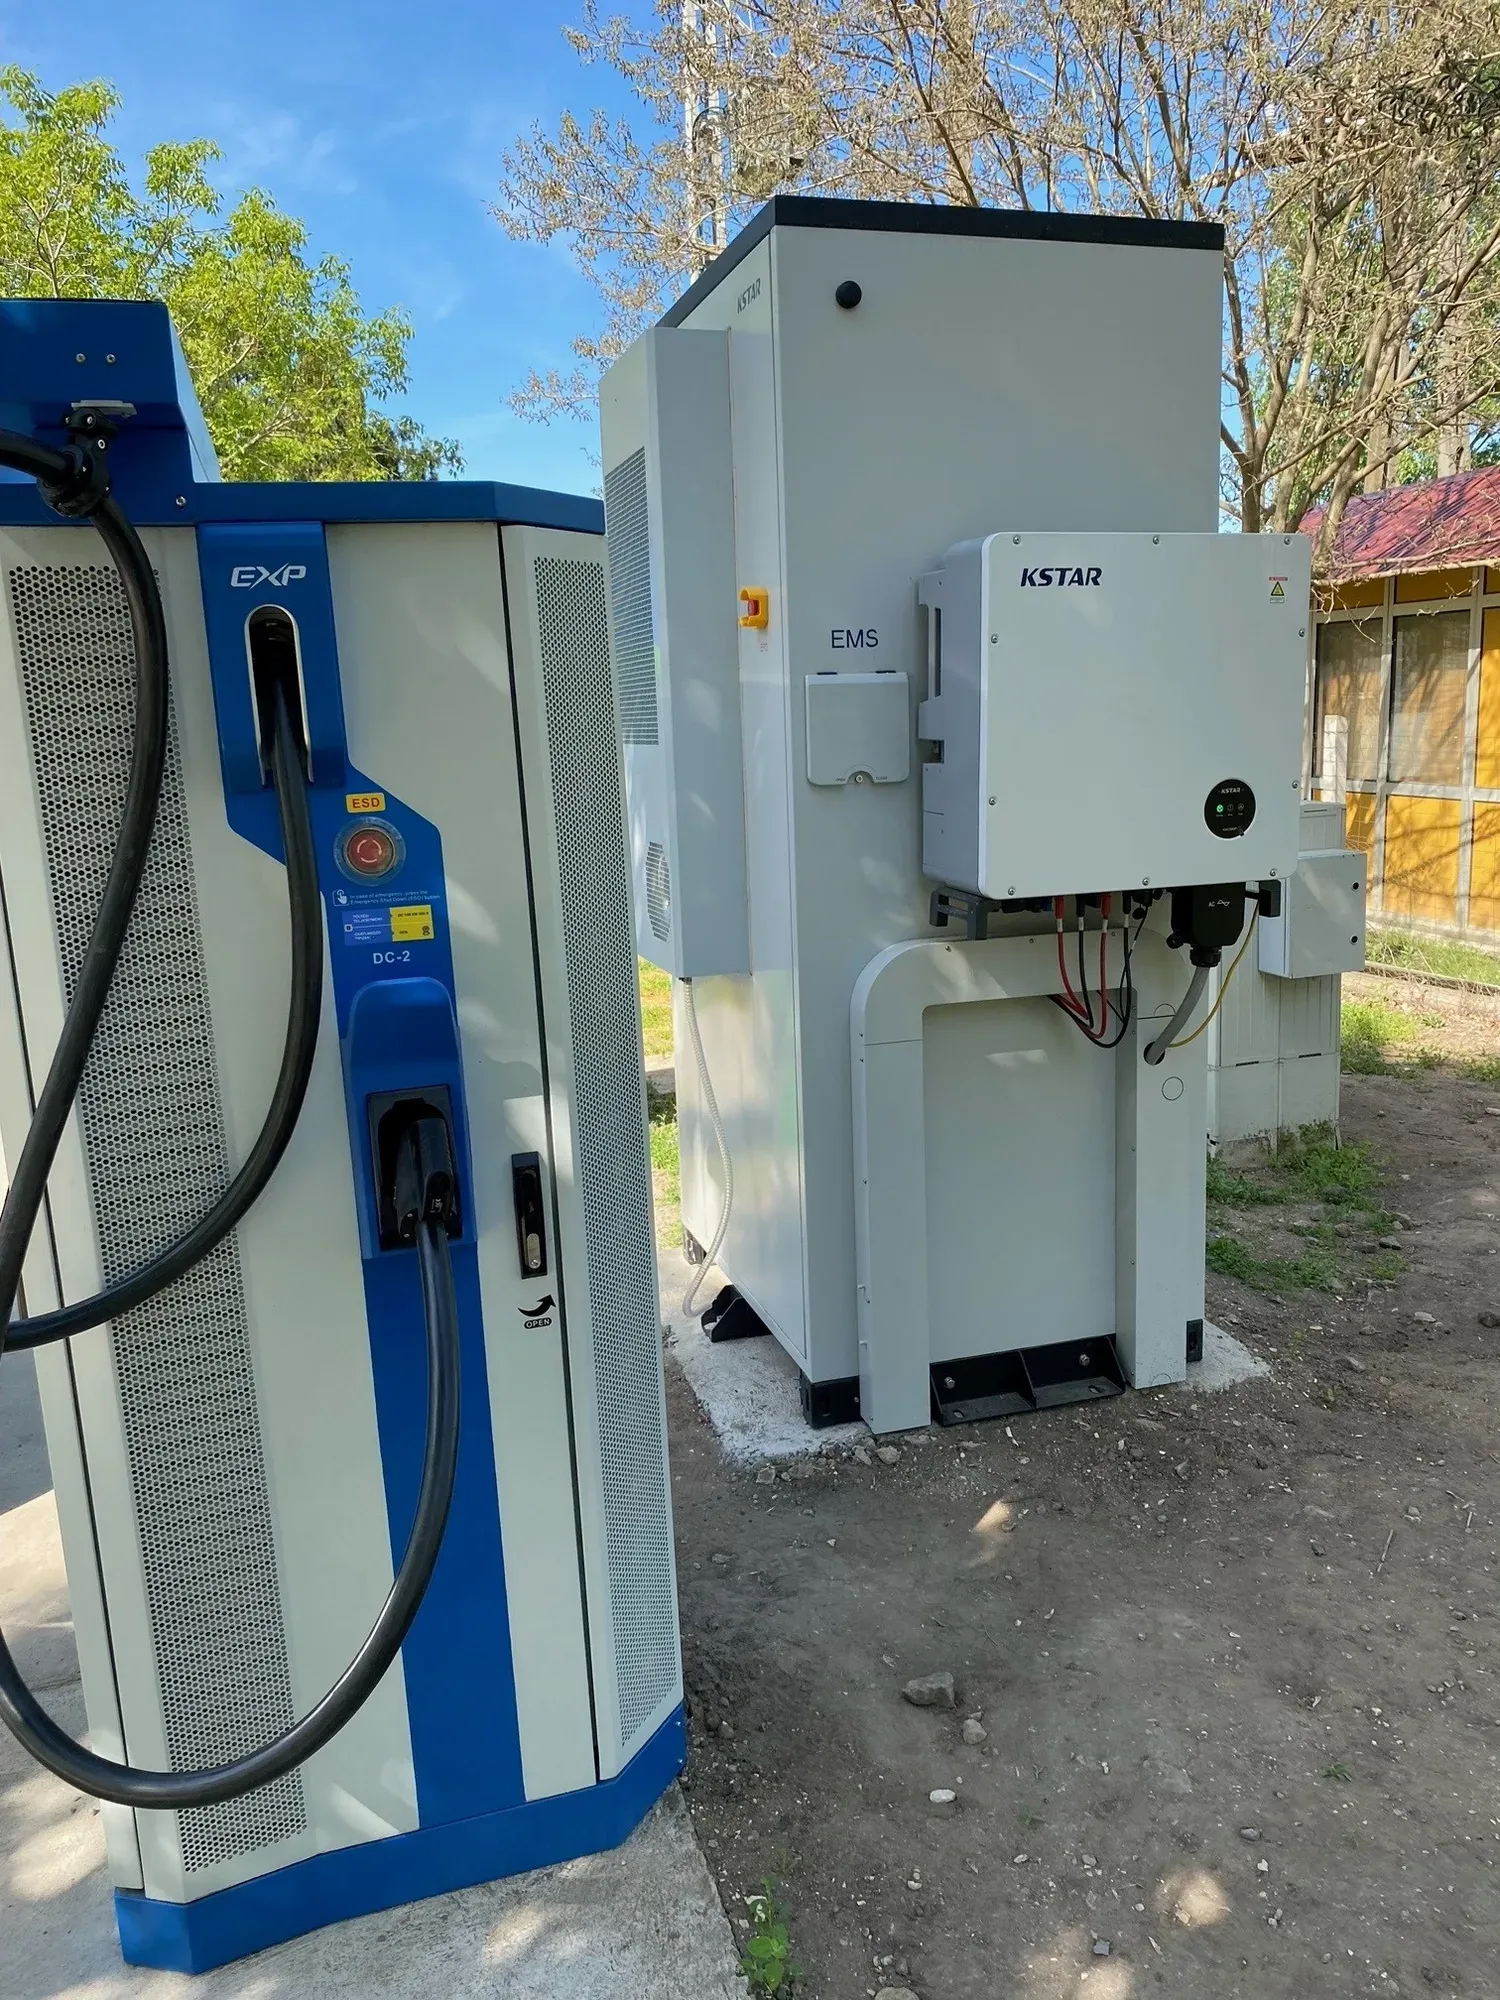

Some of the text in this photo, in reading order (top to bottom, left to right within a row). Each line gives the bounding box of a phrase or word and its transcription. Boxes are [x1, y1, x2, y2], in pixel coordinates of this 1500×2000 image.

[737, 278, 761, 314] KSTAR
[231, 562, 306, 590] EXP
[1020, 567, 1102, 587] KSTAR
[831, 629, 879, 648] EMS
[352, 797, 380, 809] ESD
[373, 951, 410, 964] DC-2
[526, 1319, 550, 1328] OPEN
